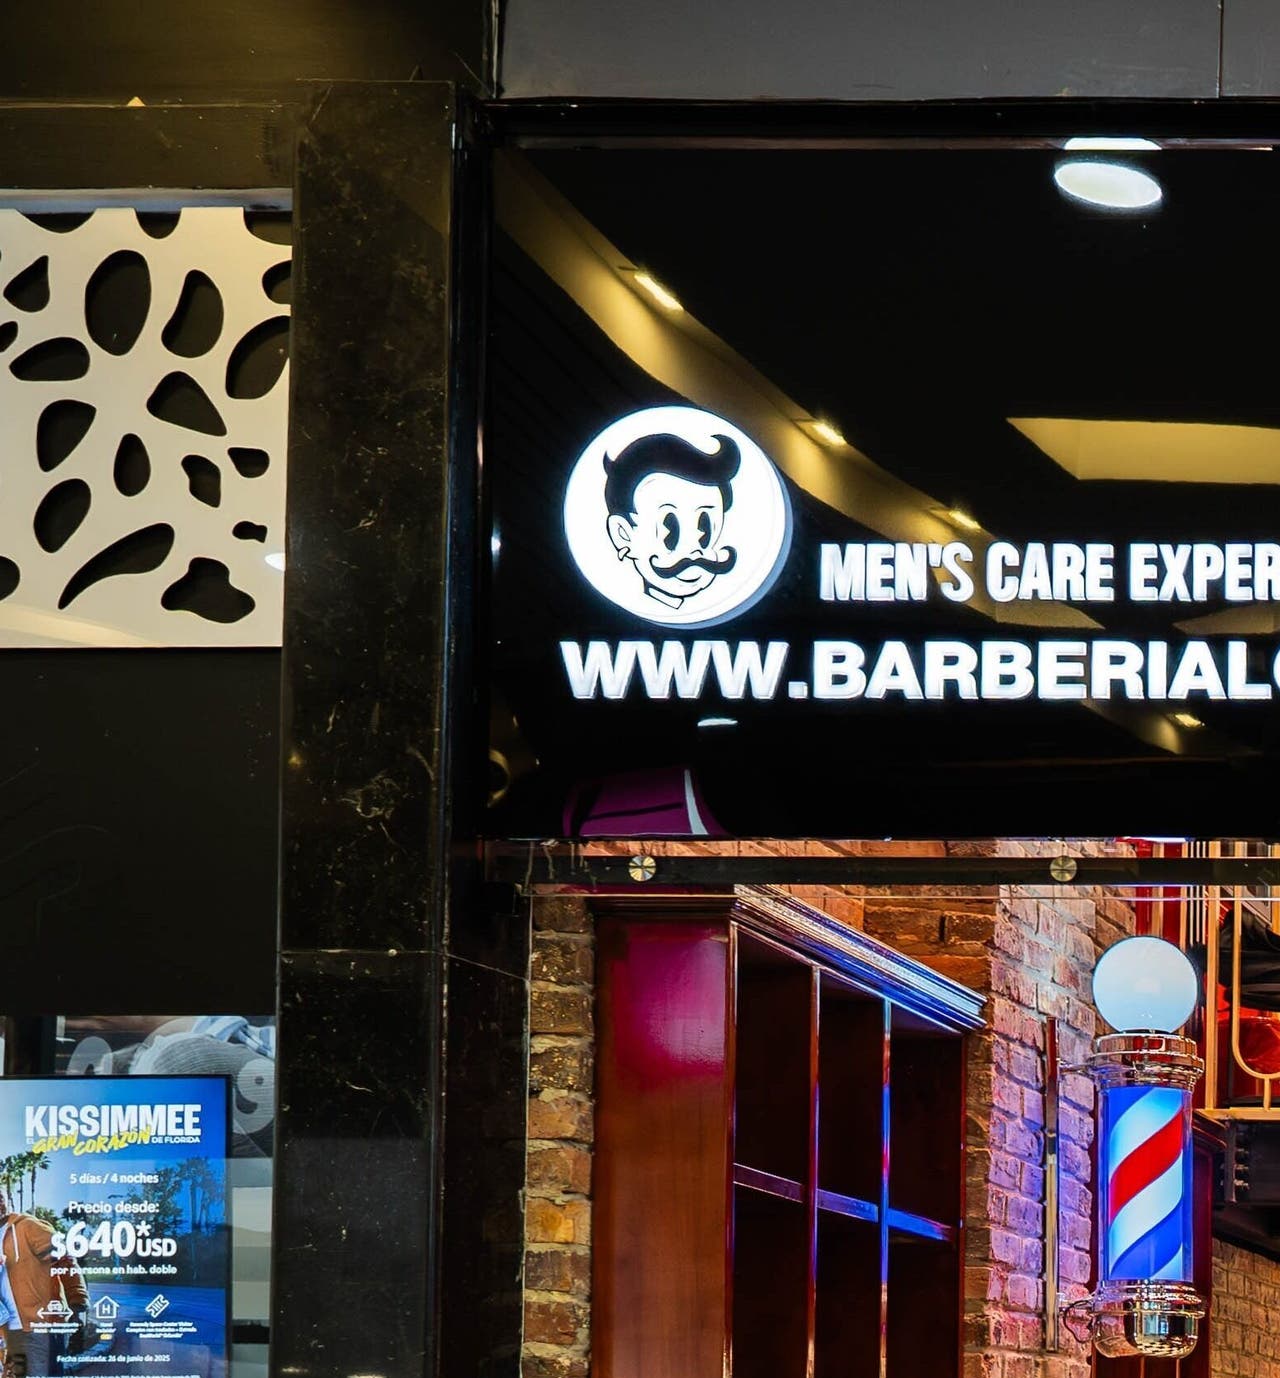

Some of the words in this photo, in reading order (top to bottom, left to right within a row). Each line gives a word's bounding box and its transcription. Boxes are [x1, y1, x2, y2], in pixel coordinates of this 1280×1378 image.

[820, 541, 975, 603] MEN'S
[986, 541, 1115, 603] CARE
[25, 1104, 202, 1137] KISSIMMEE
[70, 1173, 77, 1184] 5
[79, 1172, 102, 1184] días
[110, 1173, 118, 1183] 4
[120, 1172, 159, 1184] noches
[68, 1201, 112, 1213] Precio
[115, 1201, 160, 1213] desde:
[136, 1238, 177, 1257] USD
[51, 1267, 68, 1277] por
[70, 1267, 111, 1277] persona
[112, 1267, 125, 1275] en
[150, 1265, 178, 1275] doble
